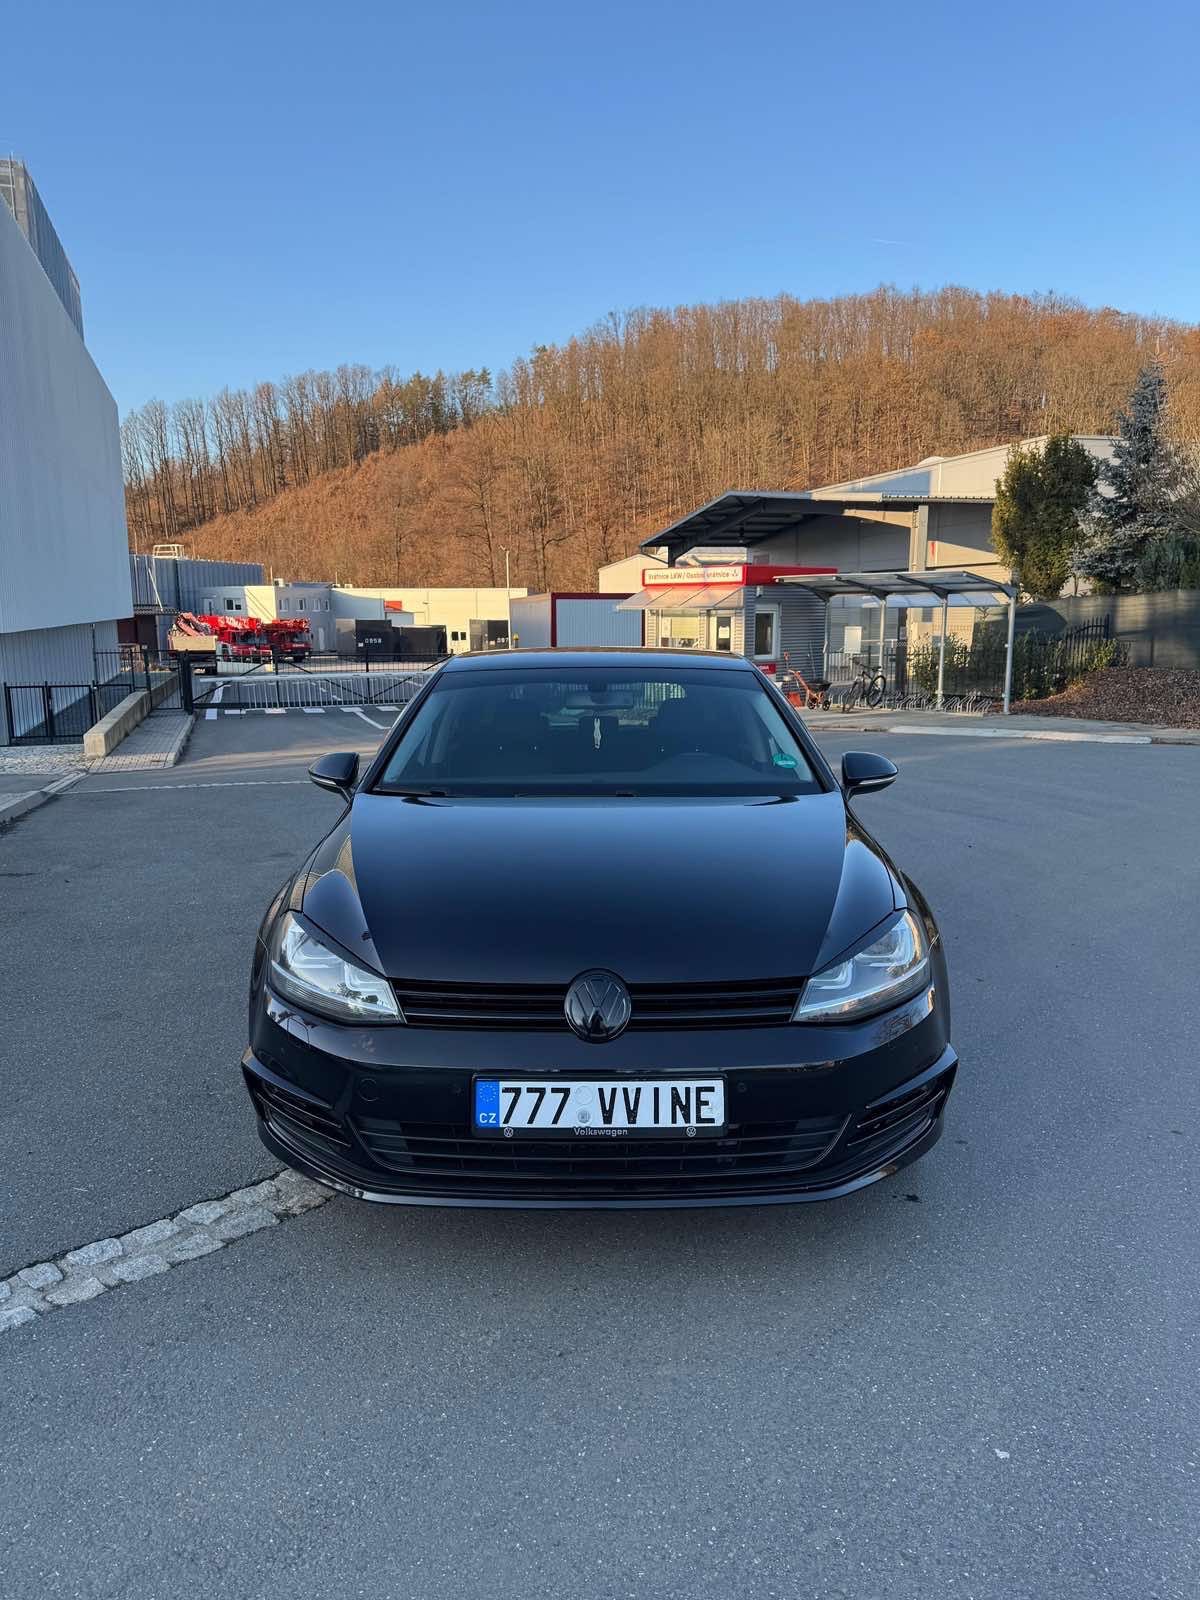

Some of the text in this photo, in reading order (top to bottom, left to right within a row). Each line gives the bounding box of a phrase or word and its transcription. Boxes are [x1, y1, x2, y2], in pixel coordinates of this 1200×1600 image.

[501, 1087, 571, 1125] 777
[479, 1112, 497, 1124] CZ
[573, 1127, 628, 1137] Volkswagen
